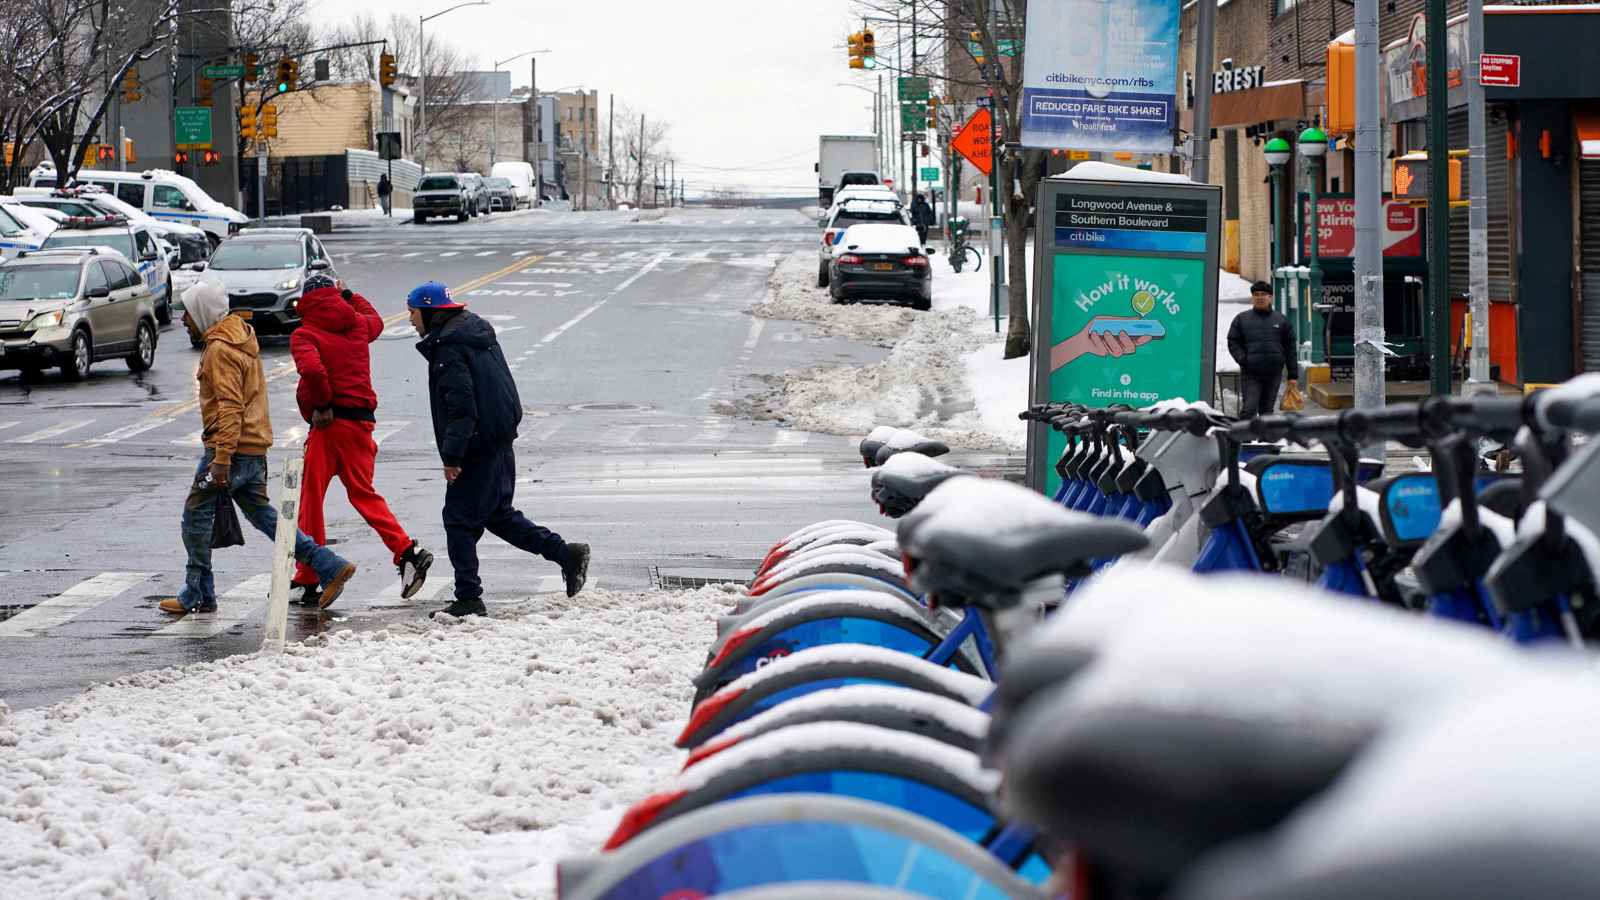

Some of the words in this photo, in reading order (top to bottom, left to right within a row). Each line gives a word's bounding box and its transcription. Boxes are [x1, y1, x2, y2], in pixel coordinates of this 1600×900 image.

[1046, 72, 1154, 88] citibikenyc.com/rfbs
[1035, 101, 1081, 112] REDUCED
[1082, 103, 1105, 113] FARE
[1107, 105, 1129, 114] BIKE
[1130, 107, 1162, 116] SHARE
[1078, 121, 1117, 131] healthfirst
[1071, 198, 1124, 211] Longwood
[1126, 201, 1163, 211] Avenue
[1165, 201, 1173, 211] &
[1070, 214, 1116, 226] Southern
[1118, 216, 1169, 228] Boulevard
[1076, 281, 1113, 312] How
[1116, 274, 1130, 290] it
[1134, 278, 1181, 316] works
[1092, 388, 1111, 398] Find
[1113, 389, 1122, 398] in
[1124, 389, 1138, 399] the
[1140, 391, 1158, 402] app
